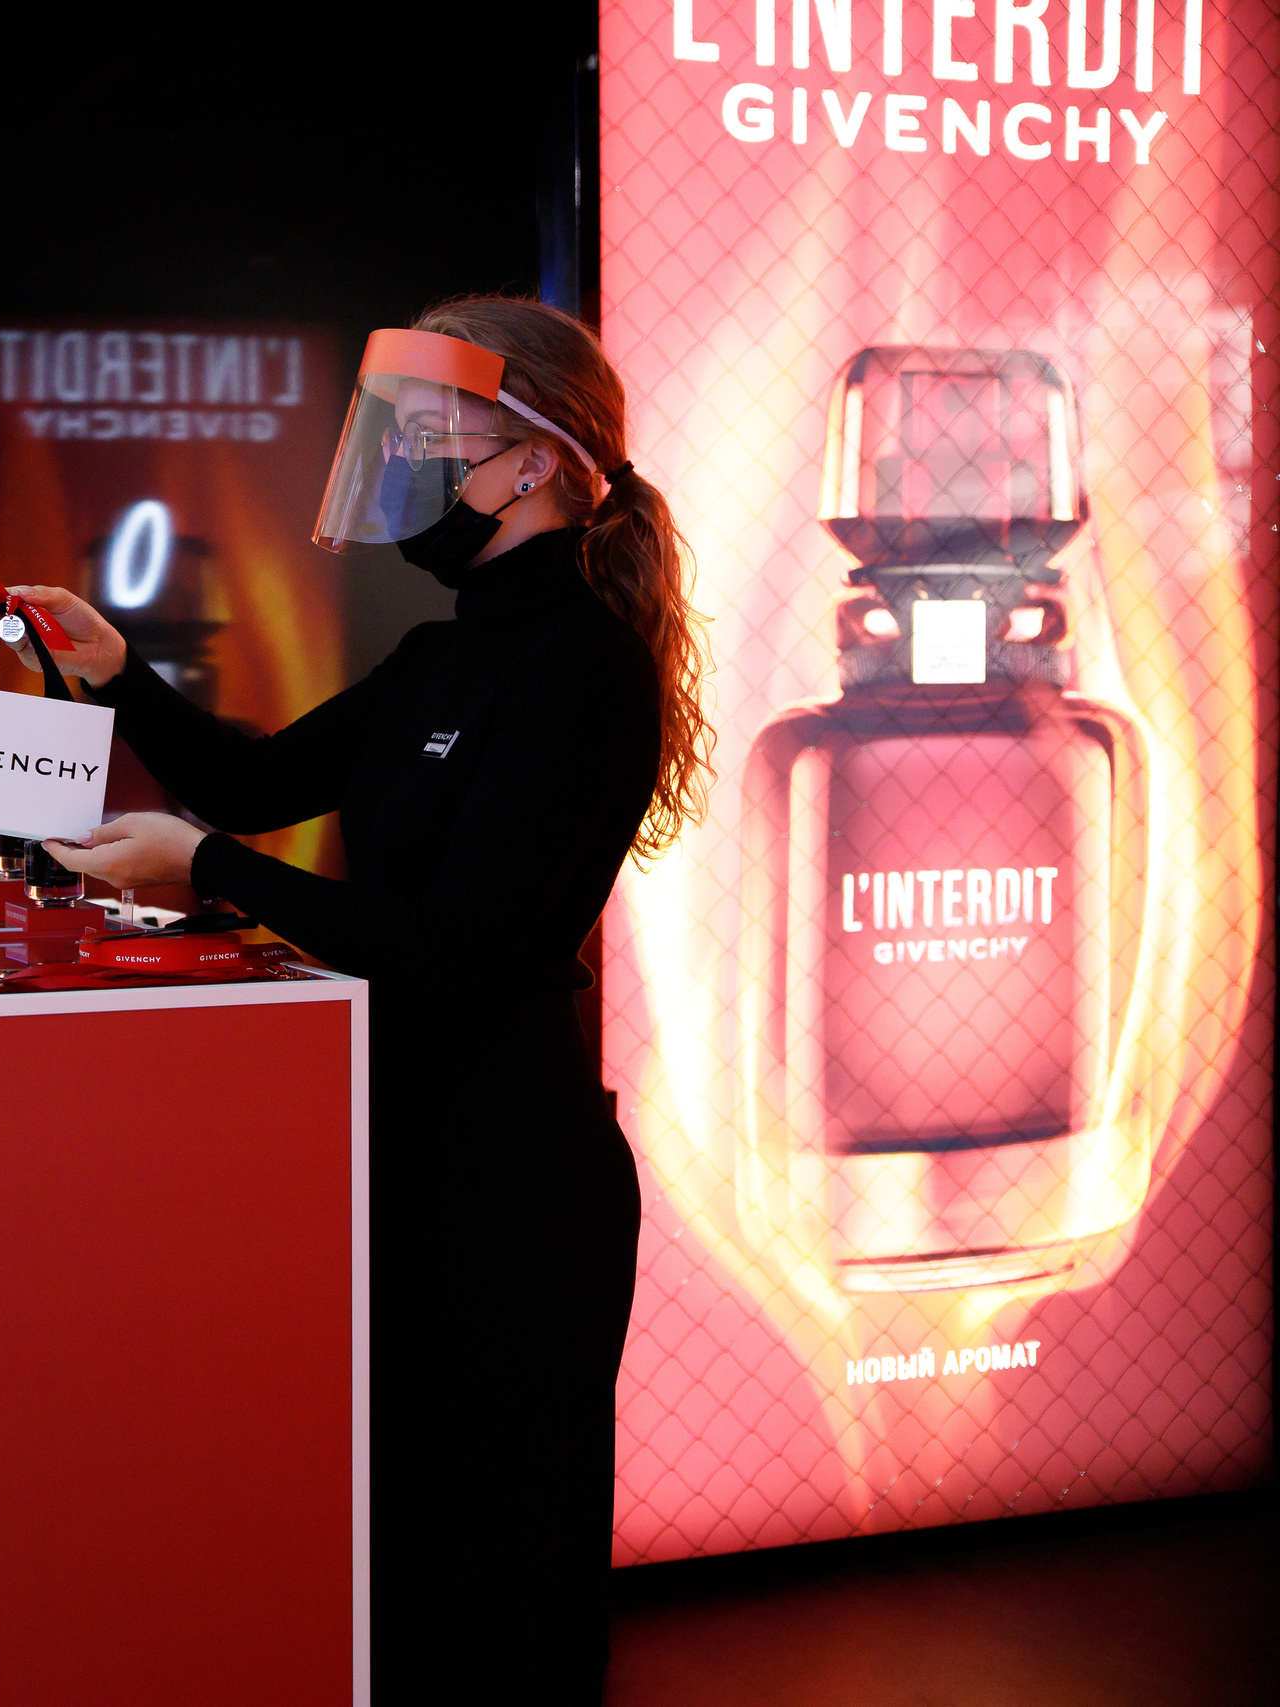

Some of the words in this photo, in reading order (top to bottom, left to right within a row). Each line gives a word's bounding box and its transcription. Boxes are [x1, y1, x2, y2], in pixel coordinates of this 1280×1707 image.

[673, 0, 1205, 95] LINTERDIT
[722, 82, 1169, 165] GIVENCHY
[842, 866, 1059, 933] L'INTERDIT
[115, 955, 162, 963] GIVENCHY
[200, 952, 240, 962] GIVENCHY
[873, 936, 1029, 965] GIVENCHY
[846, 1346, 935, 1386] НОВЫЙ
[941, 1341, 1042, 1376] АРОМАТ
